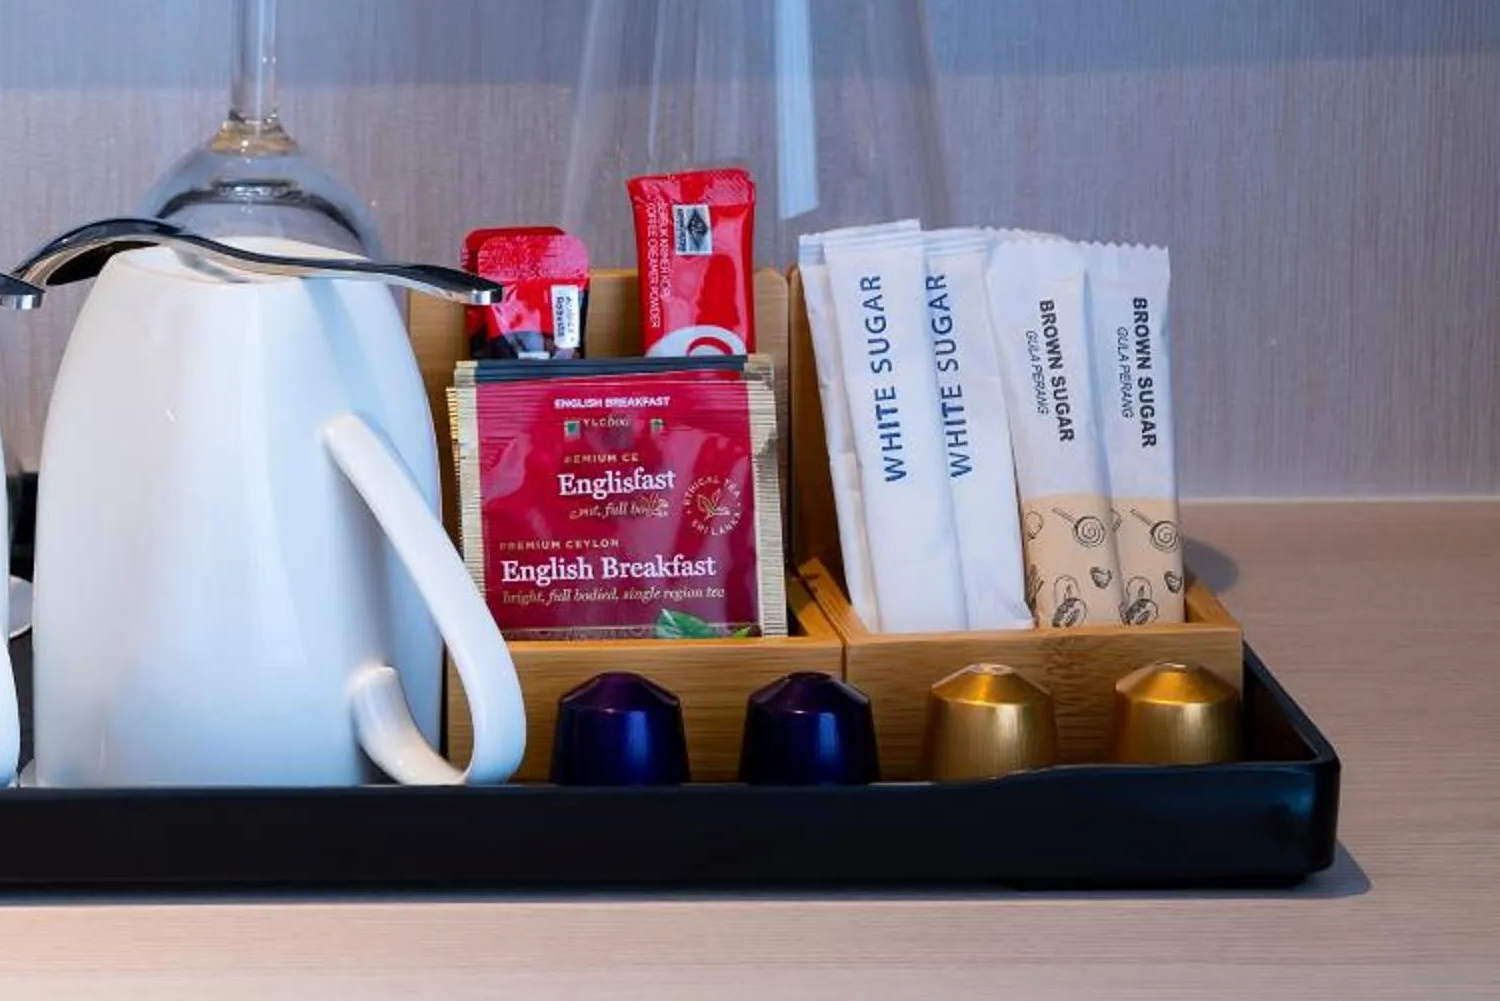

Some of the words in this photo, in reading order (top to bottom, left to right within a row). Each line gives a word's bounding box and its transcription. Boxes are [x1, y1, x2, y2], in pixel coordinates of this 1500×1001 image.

[649, 286, 661, 328] POWDER
[860, 276, 892, 373] SUGAR
[926, 275, 958, 372] SUGAR
[1040, 299, 1063, 370] BROWN
[1133, 297, 1152, 370] BROWN
[1026, 330, 1041, 362] GULA
[1117, 327, 1129, 362] GULA
[554, 398, 602, 409] ENGLISH
[605, 396, 671, 408] BREAKFAST
[1032, 364, 1049, 415] PERANG
[1051, 376, 1075, 442] SUGAR
[1120, 364, 1134, 419] PERANG
[1138, 376, 1157, 448] SUGAR
[874, 386, 906, 482] WHITE
[940, 384, 972, 477] WHITE
[500, 541, 560, 551] PREMIUM
[565, 539, 619, 549] CEYLON
[500, 556, 594, 587] English
[601, 554, 717, 579] Breakfast
